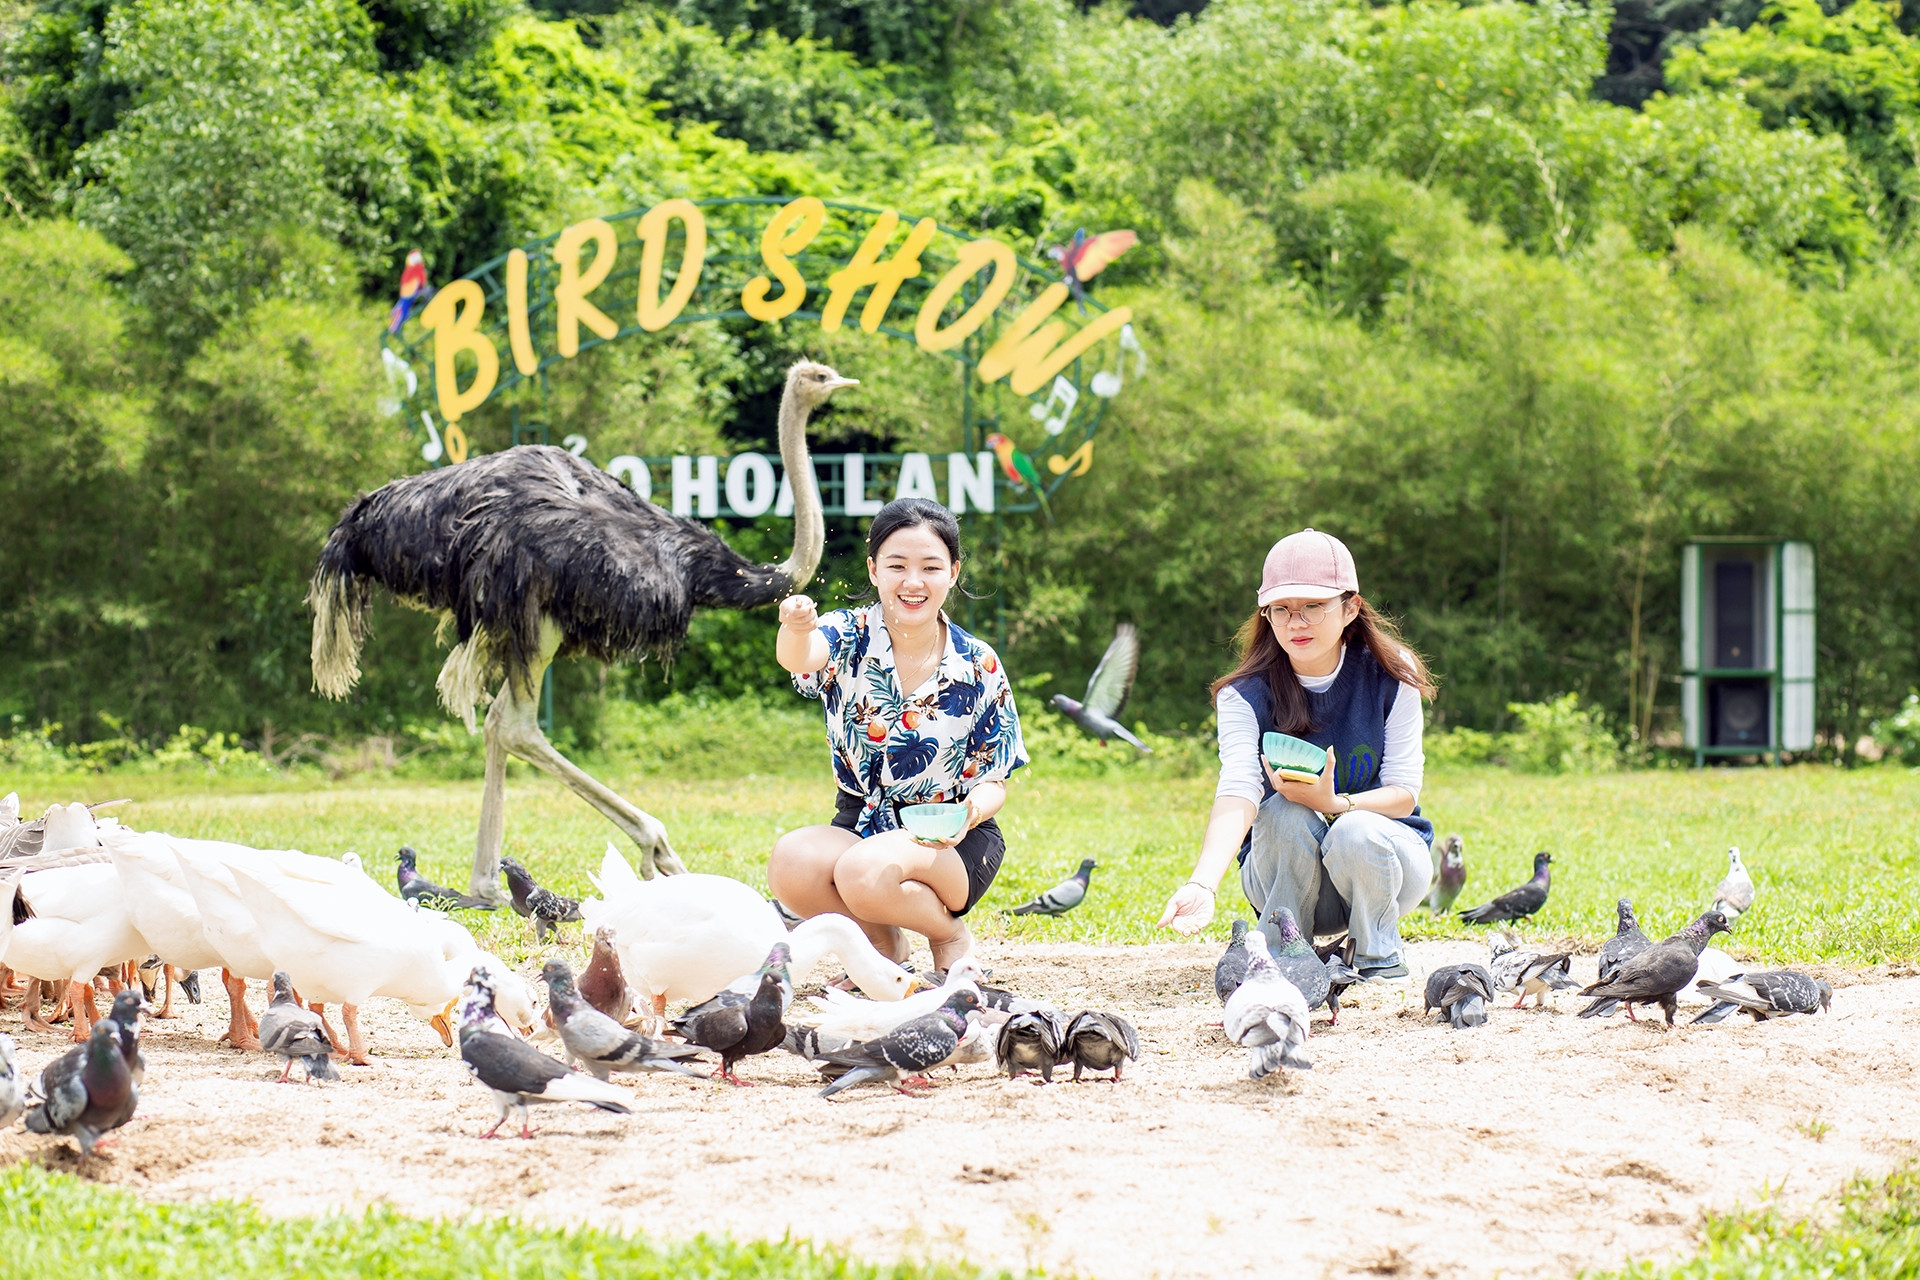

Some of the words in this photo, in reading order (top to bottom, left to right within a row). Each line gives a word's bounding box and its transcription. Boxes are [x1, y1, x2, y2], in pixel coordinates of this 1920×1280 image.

[421, 199, 707, 421] BIRD
[741, 196, 1133, 396] SHOW
[843, 451, 995, 516] LAN
